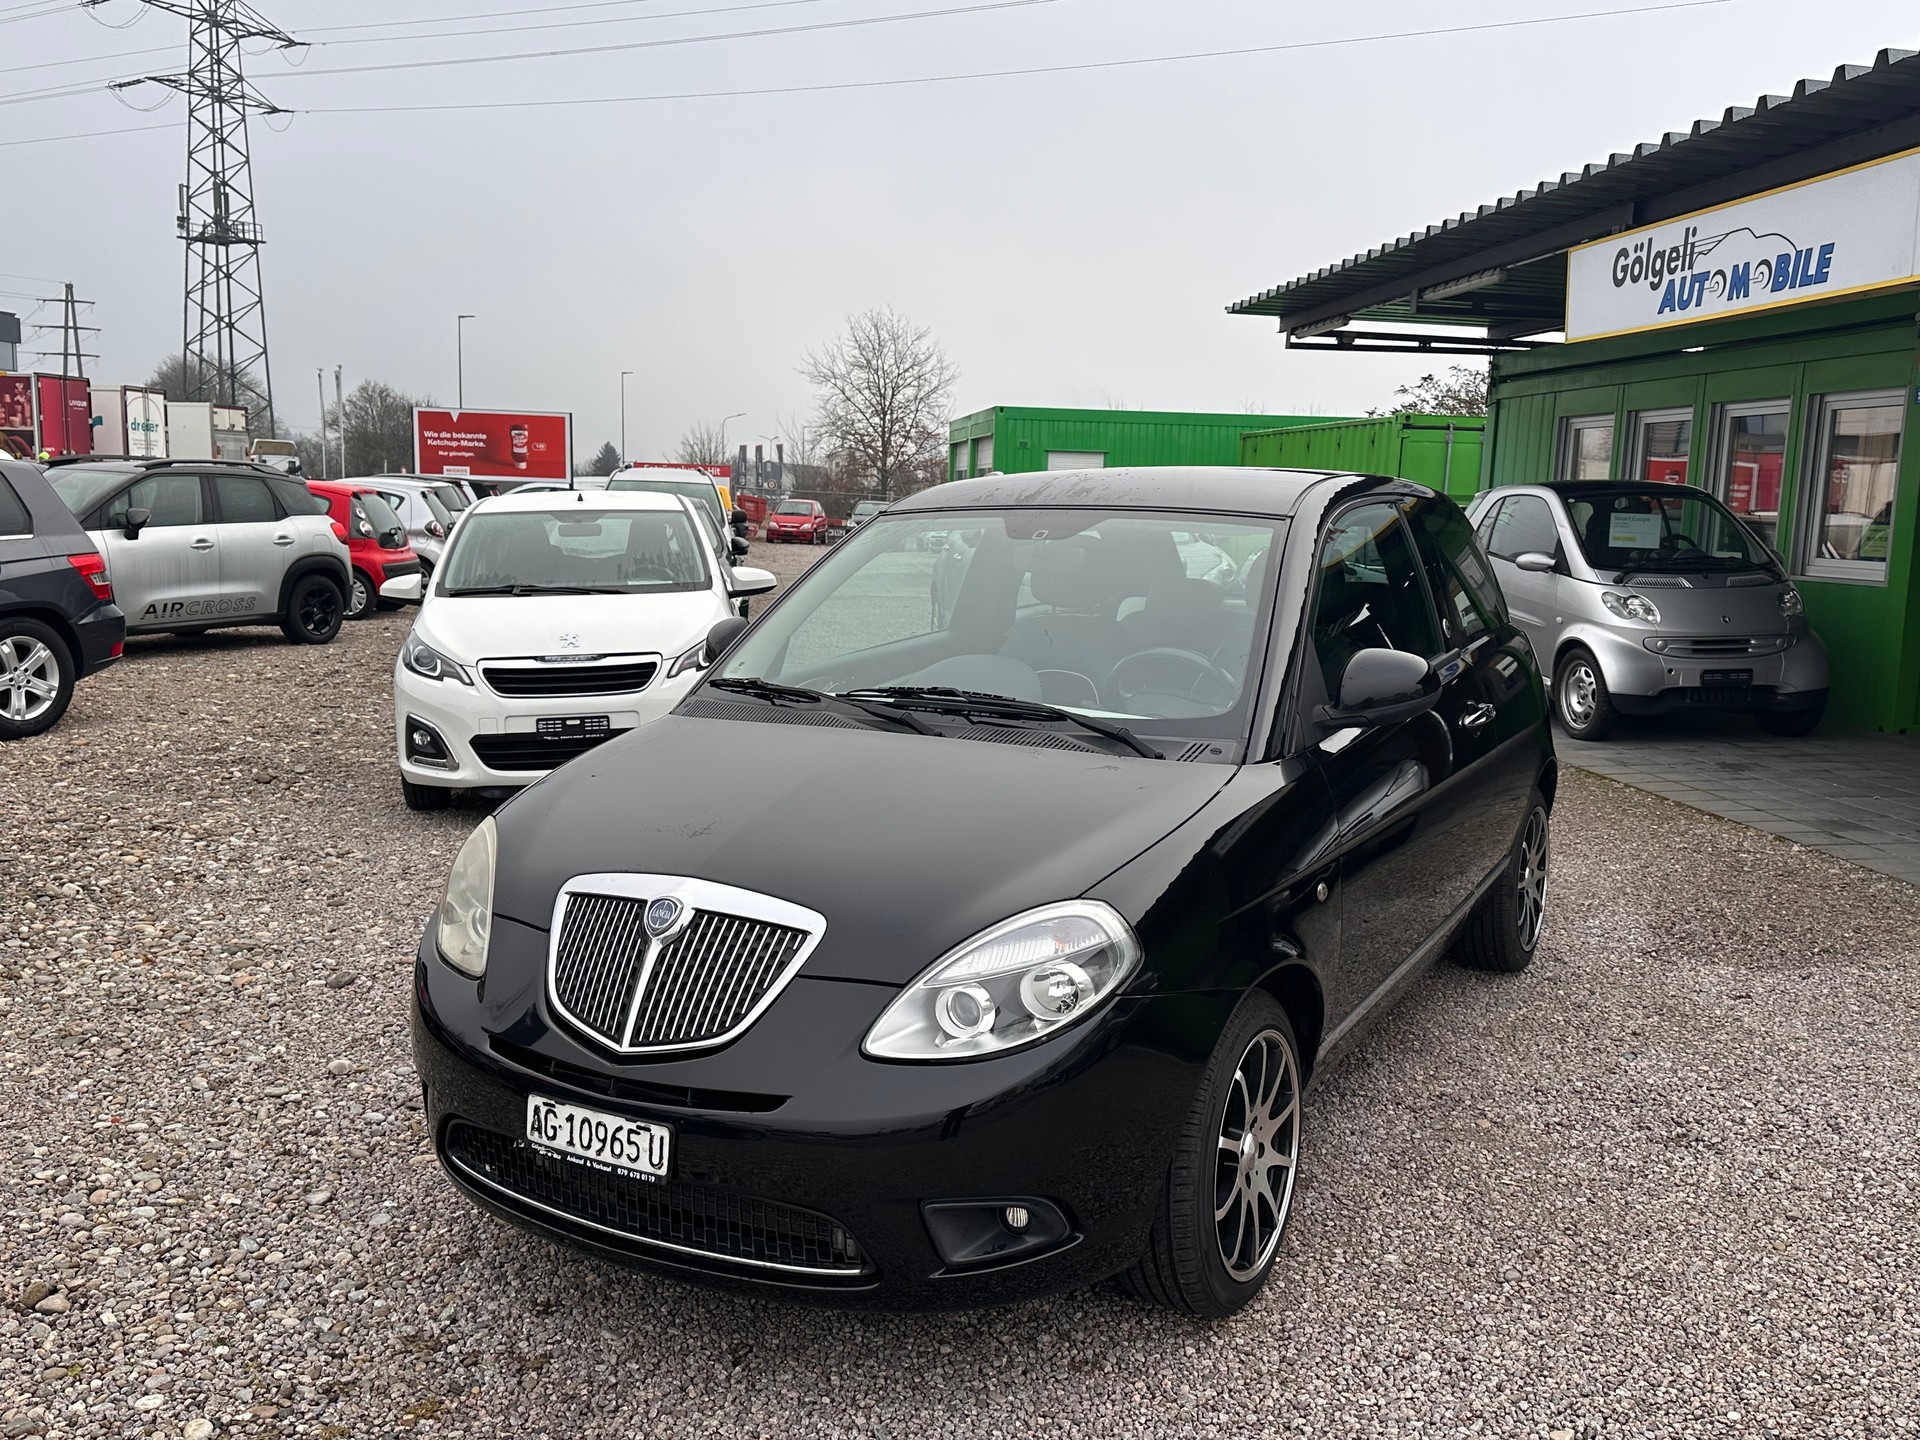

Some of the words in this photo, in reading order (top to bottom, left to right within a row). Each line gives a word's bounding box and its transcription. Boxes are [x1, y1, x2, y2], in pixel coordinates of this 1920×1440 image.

[1612, 226, 1698, 291] Gölgeli
[427, 439, 486, 447] Ketchup-Marke.
[452, 432, 487, 440] bekannte
[140, 597, 256, 620] AIRCROSS
[566, 1154, 585, 1165] Ankauf
[586, 1159, 592, 1167] &
[592, 1161, 612, 1173] Verkauf
[617, 1168, 628, 1176] 079
[629, 1171, 641, 1180] 678
